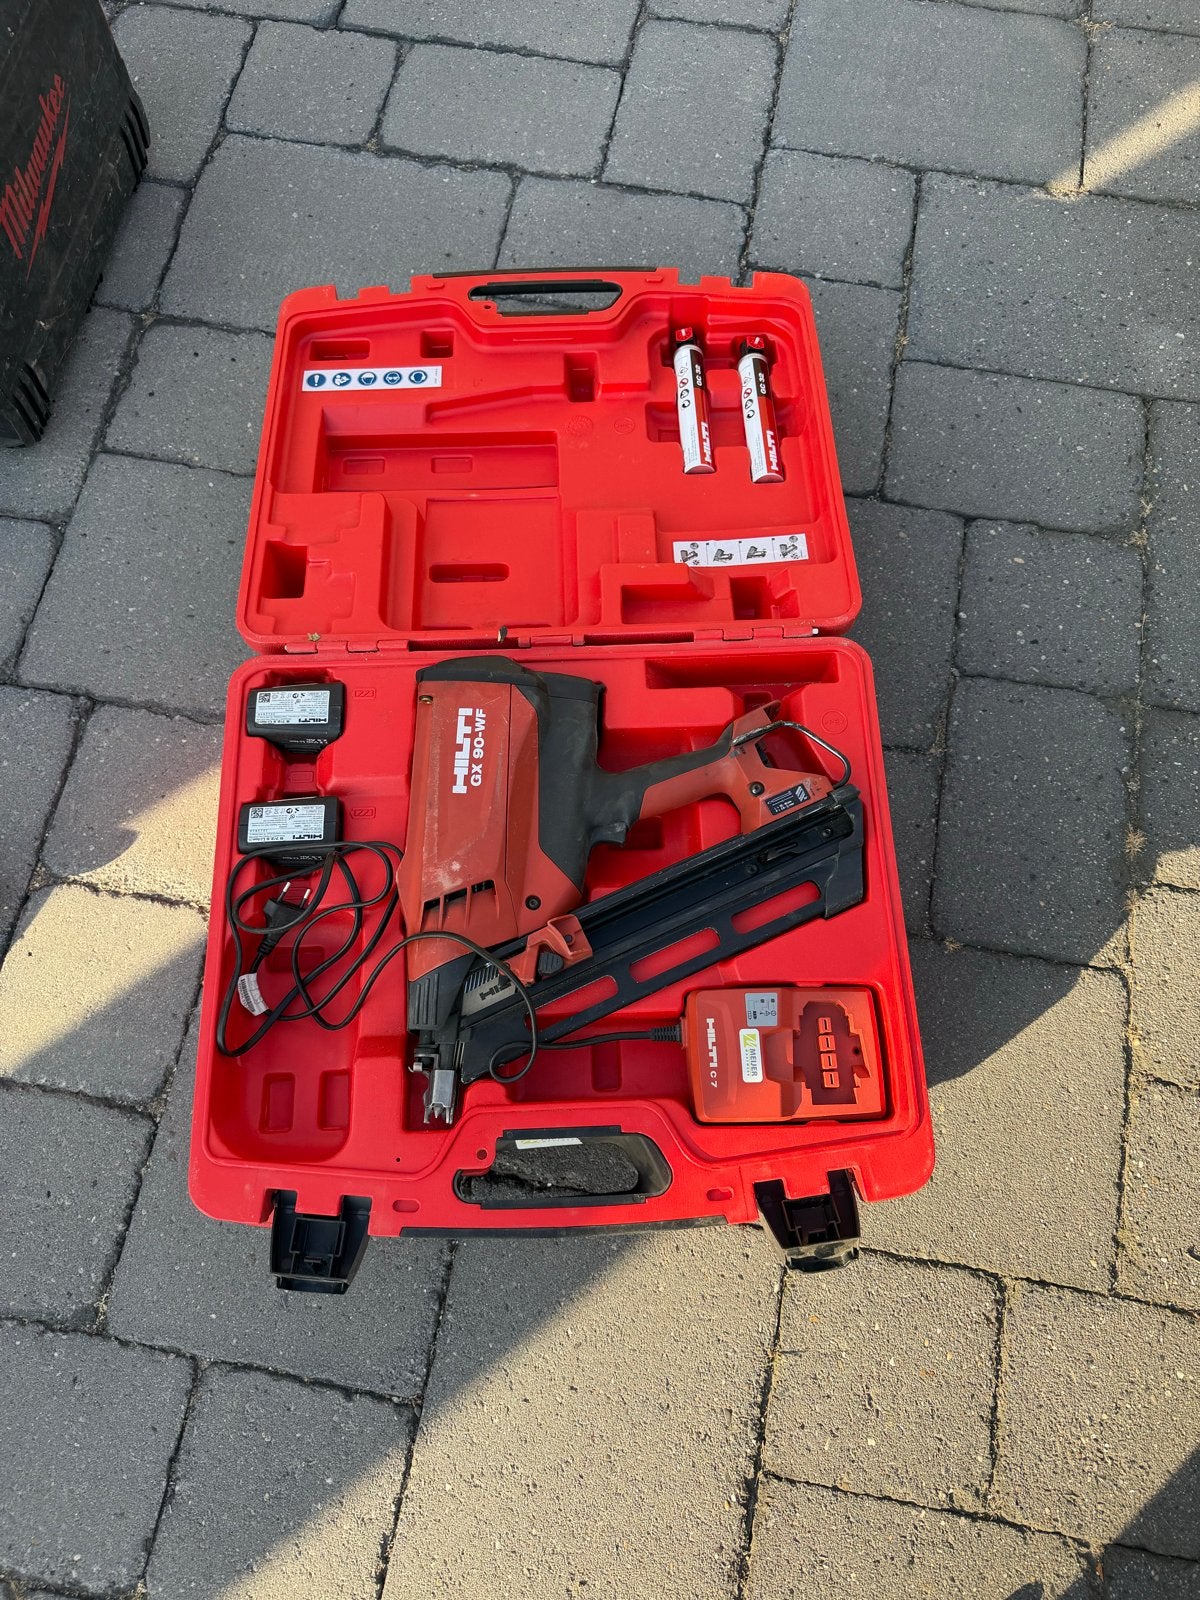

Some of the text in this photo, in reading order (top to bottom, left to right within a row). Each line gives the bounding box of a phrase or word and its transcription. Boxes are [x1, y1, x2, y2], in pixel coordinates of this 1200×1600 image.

[0, 73, 66, 260] Milwaukee
[701, 421, 713, 464] HILTI
[766, 430, 779, 471] HILTI
[452, 708, 473, 794] HILTI
[470, 708, 487, 787] GX 90-WF
[706, 1017, 718, 1068] HILTI
[749, 1048, 758, 1077] MEIJER
[710, 1080, 718, 1088] 7
